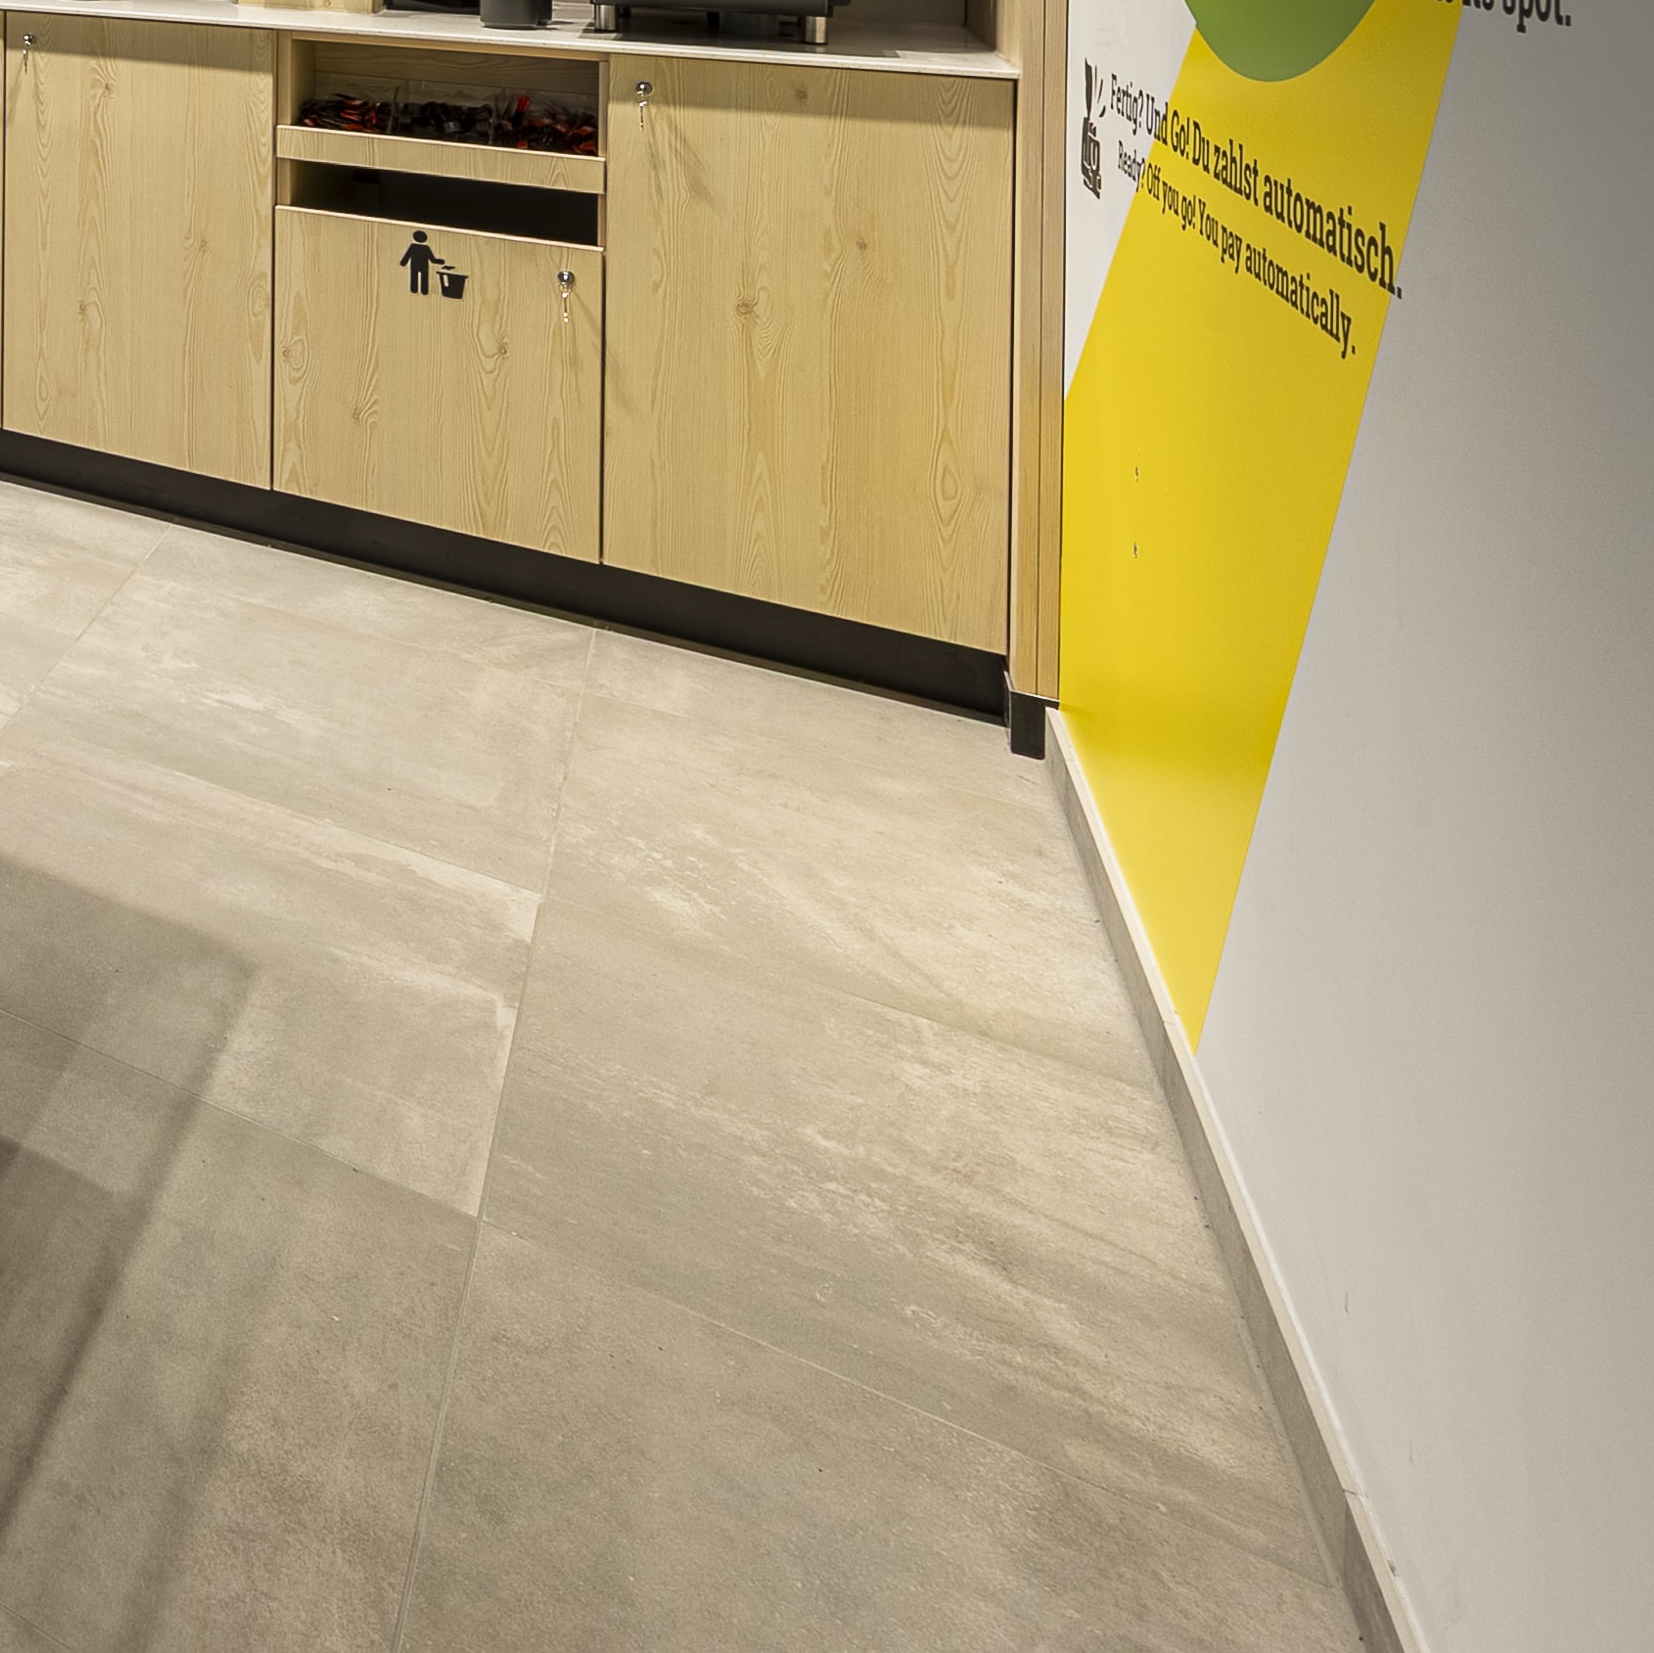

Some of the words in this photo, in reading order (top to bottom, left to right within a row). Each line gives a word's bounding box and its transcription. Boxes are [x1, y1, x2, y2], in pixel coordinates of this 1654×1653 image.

[1110, 72, 1144, 136] Fertig?
[1145, 93, 1169, 145] Und
[1170, 109, 1191, 161] Go!
[1192, 120, 1211, 175] Du
[1213, 137, 1259, 207] zahlst
[1263, 173, 1403, 300] automatisch.
[1117, 139, 1146, 194] Ready?
[1146, 161, 1161, 202] Off
[1162, 179, 1179, 217] you
[1180, 194, 1196, 232] go!
[1198, 197, 1219, 248] You
[1220, 223, 1243, 275] pay
[1245, 242, 1357, 361] automatically.
